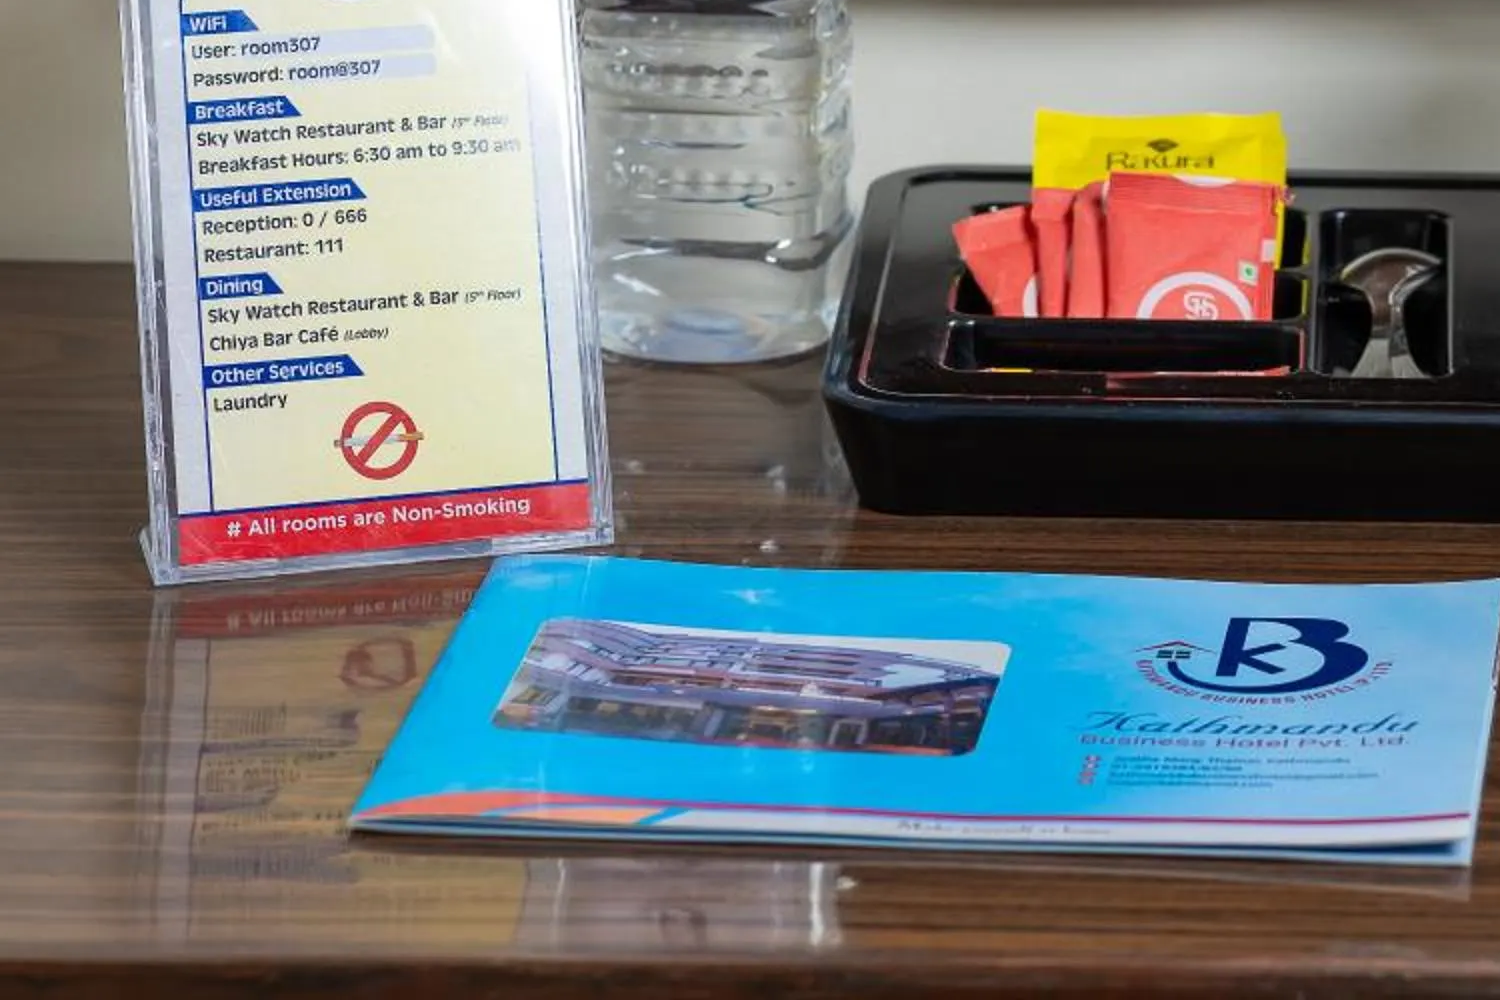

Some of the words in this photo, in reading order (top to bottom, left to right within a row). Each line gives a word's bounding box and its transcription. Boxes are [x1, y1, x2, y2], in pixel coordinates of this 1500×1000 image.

[190, 15, 227, 32] WiFi
[192, 44, 236, 59] User:
[241, 36, 321, 56] room307
[193, 67, 284, 87] Password:
[289, 59, 381, 81] room@307
[195, 100, 284, 120] Breakfast
[197, 131, 228, 148] Sky
[234, 126, 291, 144] Watch
[297, 118, 395, 139] Restaurant
[401, 117, 413, 132] &
[418, 115, 447, 131] Bar
[199, 156, 287, 175] Breakfast
[293, 151, 349, 167] Hours:
[353, 146, 390, 163] 6:30
[396, 145, 423, 159] am
[428, 143, 447, 157] to
[452, 139, 489, 155] 9:30
[493, 140, 522, 153] am
[201, 188, 257, 207] Useful
[263, 182, 351, 203] Extension
[202, 214, 297, 235] Reception:
[318, 211, 328, 228] /
[335, 208, 367, 224] 666
[204, 241, 310, 263] Restaurant:
[314, 238, 344, 254] 111
[206, 278, 263, 296] Dining
[208, 308, 240, 324] Sky
[245, 302, 303, 320] Watch
[308, 295, 408, 315] Restaurant
[413, 291, 425, 307] &
[429, 290, 459, 305] Bar
[210, 335, 259, 351] Chiya
[264, 333, 293, 347] Bar
[298, 326, 339, 344] Café
[344, 327, 389, 342] (Lobby)
[212, 367, 264, 384] Other
[269, 361, 344, 379] Services
[213, 393, 288, 412] Laundry
[227, 521, 241, 537] #
[249, 518, 275, 536] All
[283, 515, 347, 533] rooms
[354, 511, 385, 526] are
[392, 496, 531, 523] Non-Smoking
[1088, 711, 1419, 735] Kathmandu
[1080, 735, 1206, 747] Business
[1215, 735, 1289, 748] Hotel
[1299, 736, 1349, 748] Pvt.
[1361, 735, 1409, 747] Ltd.
